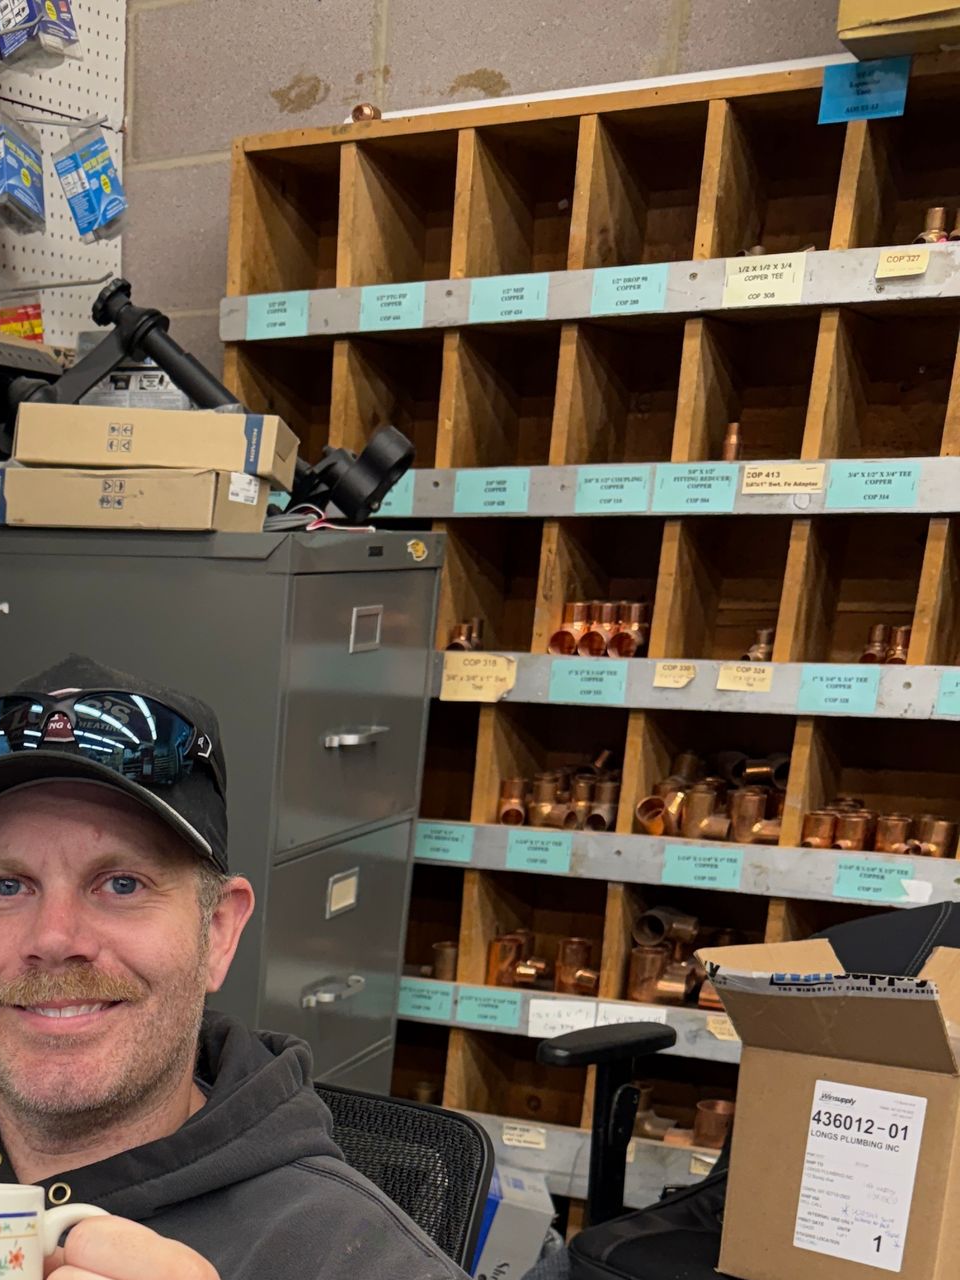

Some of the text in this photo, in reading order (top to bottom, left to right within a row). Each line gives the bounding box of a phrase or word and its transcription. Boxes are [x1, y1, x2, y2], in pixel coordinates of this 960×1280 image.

[886, 254, 921, 264] COP 327
[738, 265, 751, 273] 1/2
[758, 263, 772, 272] 1/2
[779, 262, 793, 270] 3/4
[743, 272, 785, 283] COPPER TEE
[500, 294, 525, 302] COPPER
[747, 292, 762, 301] COP
[764, 470, 781, 478] 413
[463, 659, 482, 667] COP
[845, 985, 874, 993] FAMILY
[819, 1092, 857, 1106] Winsupply
[811, 1109, 909, 1141] 436012-01
[810, 1129, 900, 1153] LONGS PLUMBING INC
[872, 1234, 883, 1253] 1
